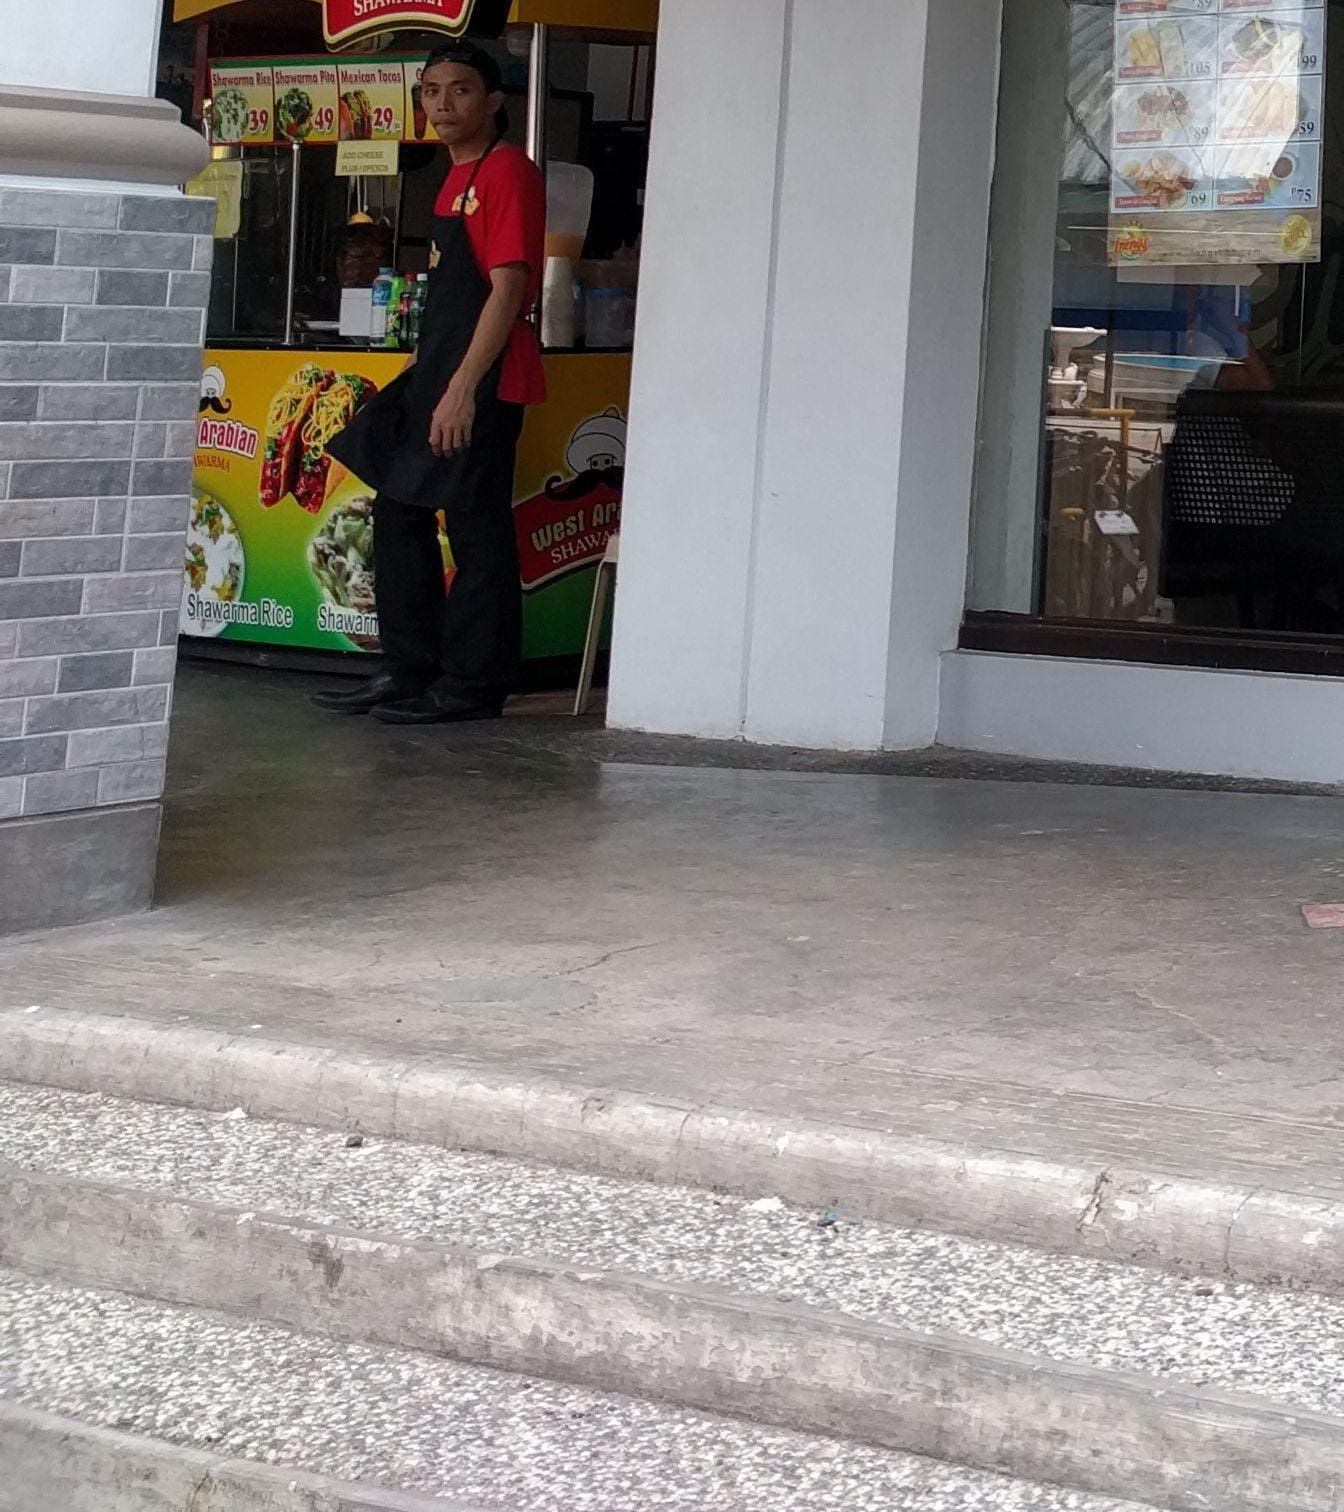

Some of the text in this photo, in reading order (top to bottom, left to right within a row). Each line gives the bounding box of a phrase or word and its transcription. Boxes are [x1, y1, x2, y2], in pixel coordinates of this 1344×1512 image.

[212, 72, 272, 87] Shawarma Rice
[275, 70, 335, 86] Shawarma Pita
[341, 70, 376, 83] Mexican
[378, 69, 402, 84] Tacos
[249, 109, 268, 132] 39
[314, 107, 334, 131] 49
[373, 107, 394, 128] 29
[199, 419, 258, 458] Arabian
[531, 509, 585, 551] West
[187, 593, 294, 628] Shawarma Rice
